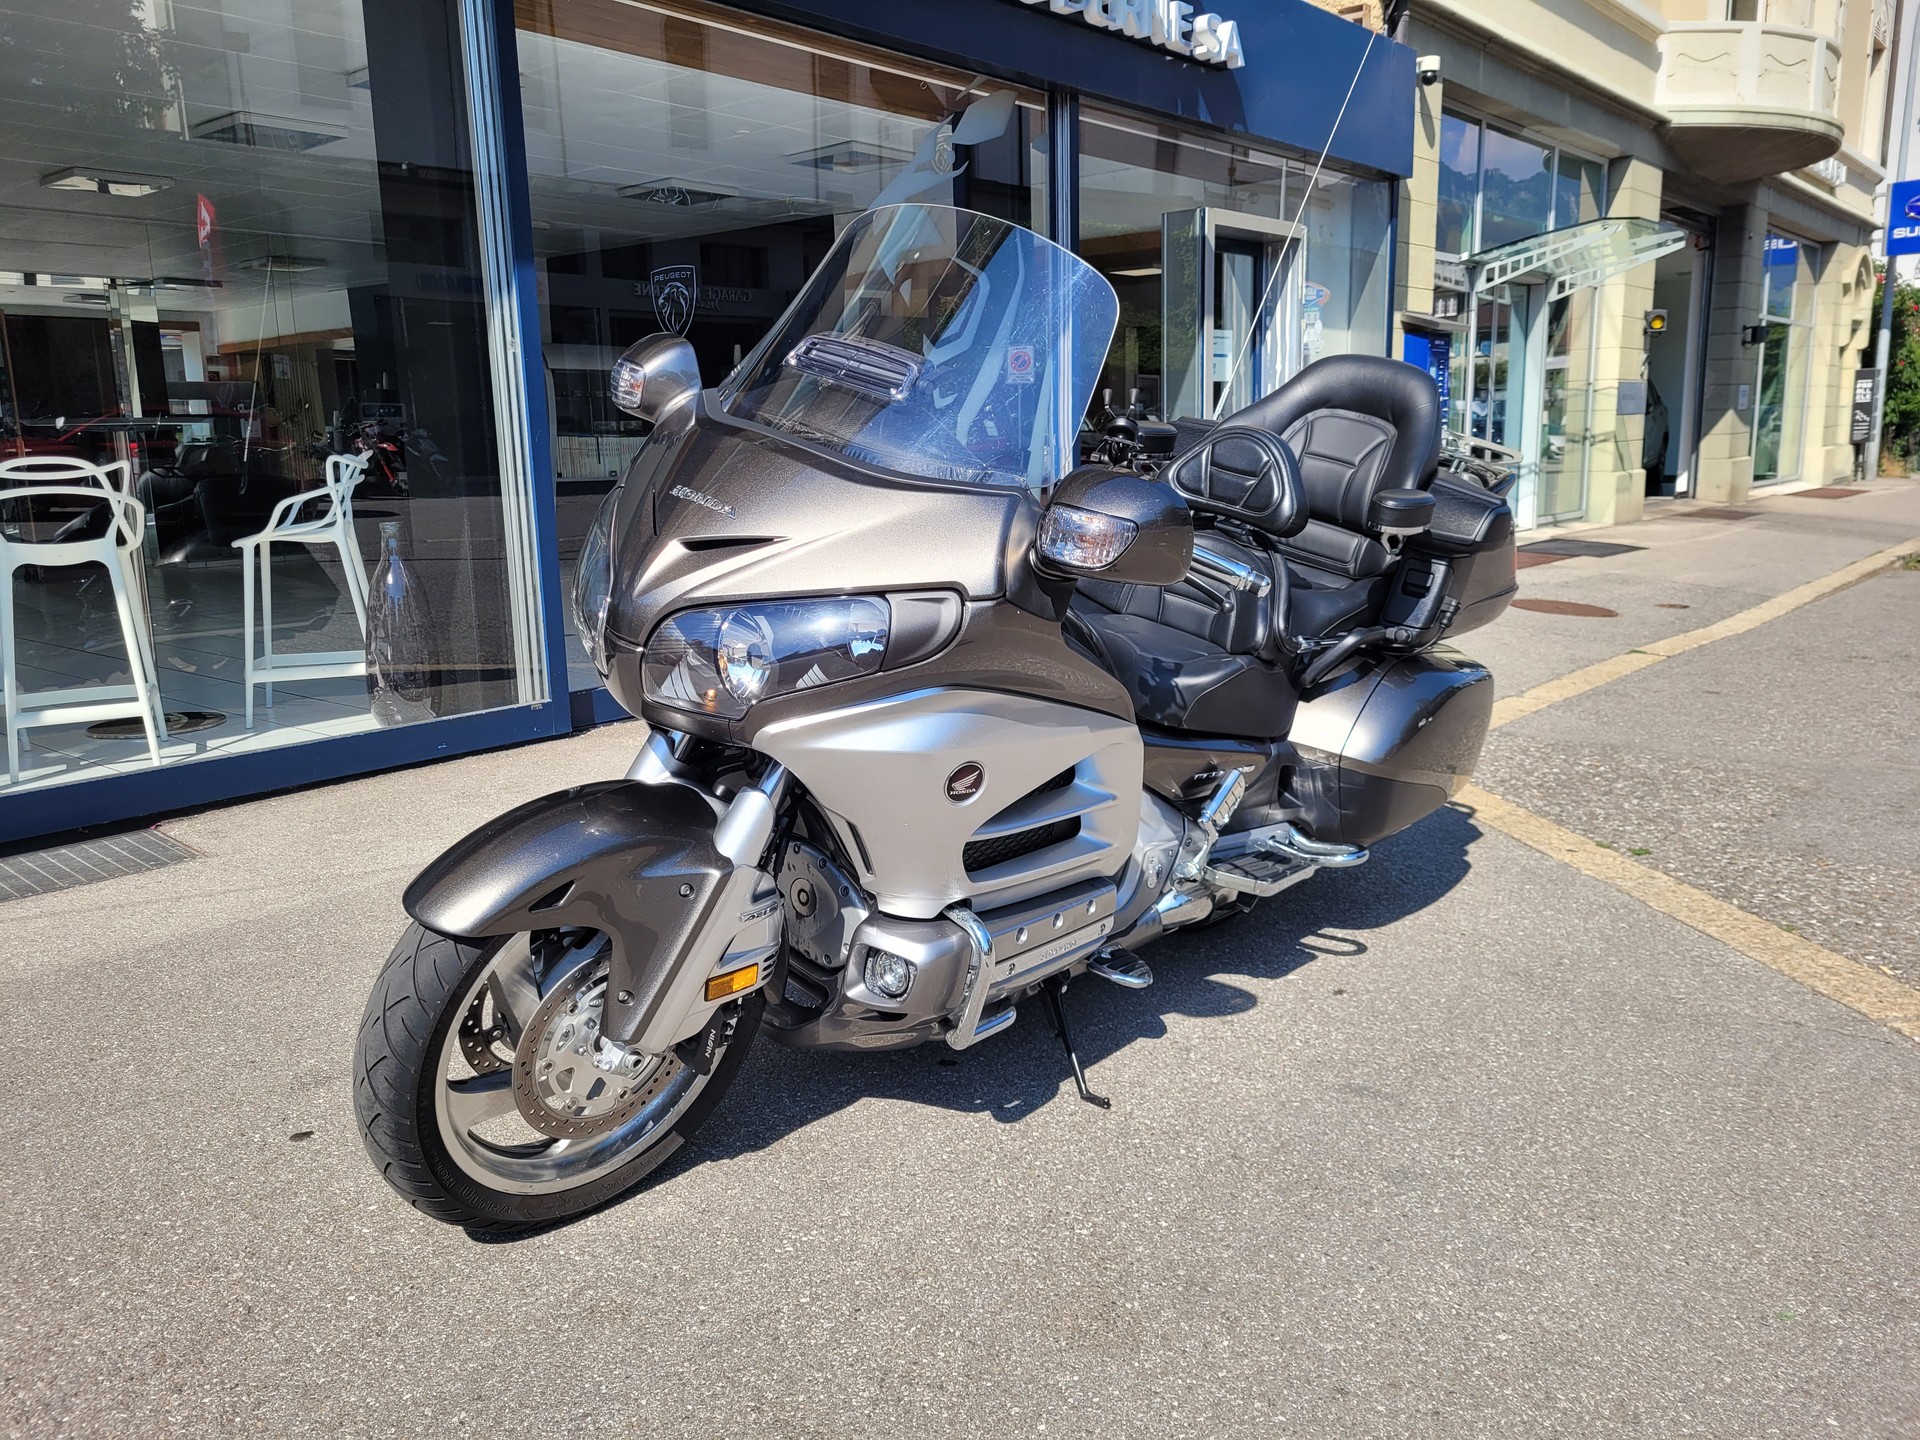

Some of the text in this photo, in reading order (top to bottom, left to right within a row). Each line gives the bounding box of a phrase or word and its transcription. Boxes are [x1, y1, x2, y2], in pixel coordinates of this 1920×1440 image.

[1192, 12, 1246, 69] SA
[1892, 226, 1920, 239] SU
[654, 271, 692, 282] PEUGEOT
[669, 485, 737, 520] HONDA
